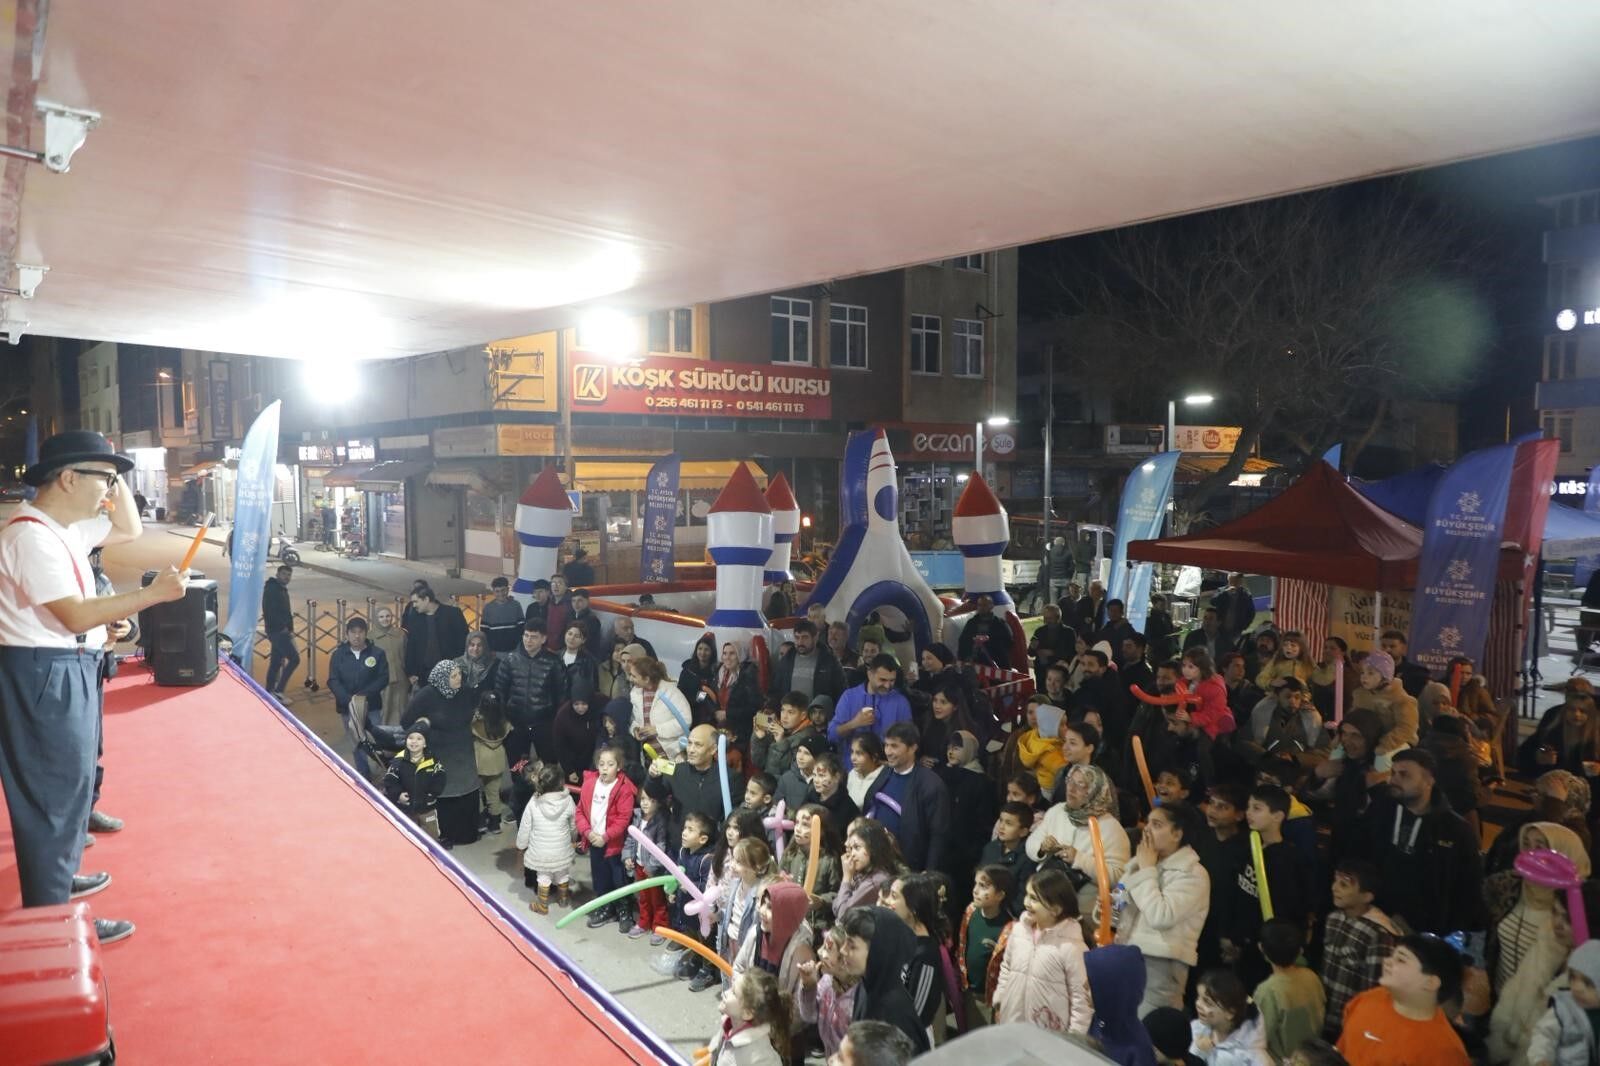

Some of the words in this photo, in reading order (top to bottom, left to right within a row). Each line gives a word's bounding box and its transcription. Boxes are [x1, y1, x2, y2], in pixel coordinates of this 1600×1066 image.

[612, 363, 675, 390] KÖŞK
[679, 367, 763, 392] SÜRÜCÜ
[767, 376, 830, 396] KURSU
[645, 397, 654, 407] 0
[655, 397, 677, 408] 256
[679, 398, 698, 408] 461
[736, 400, 745, 410] 0
[746, 401, 763, 411] 541
[765, 402, 782, 412] 461
